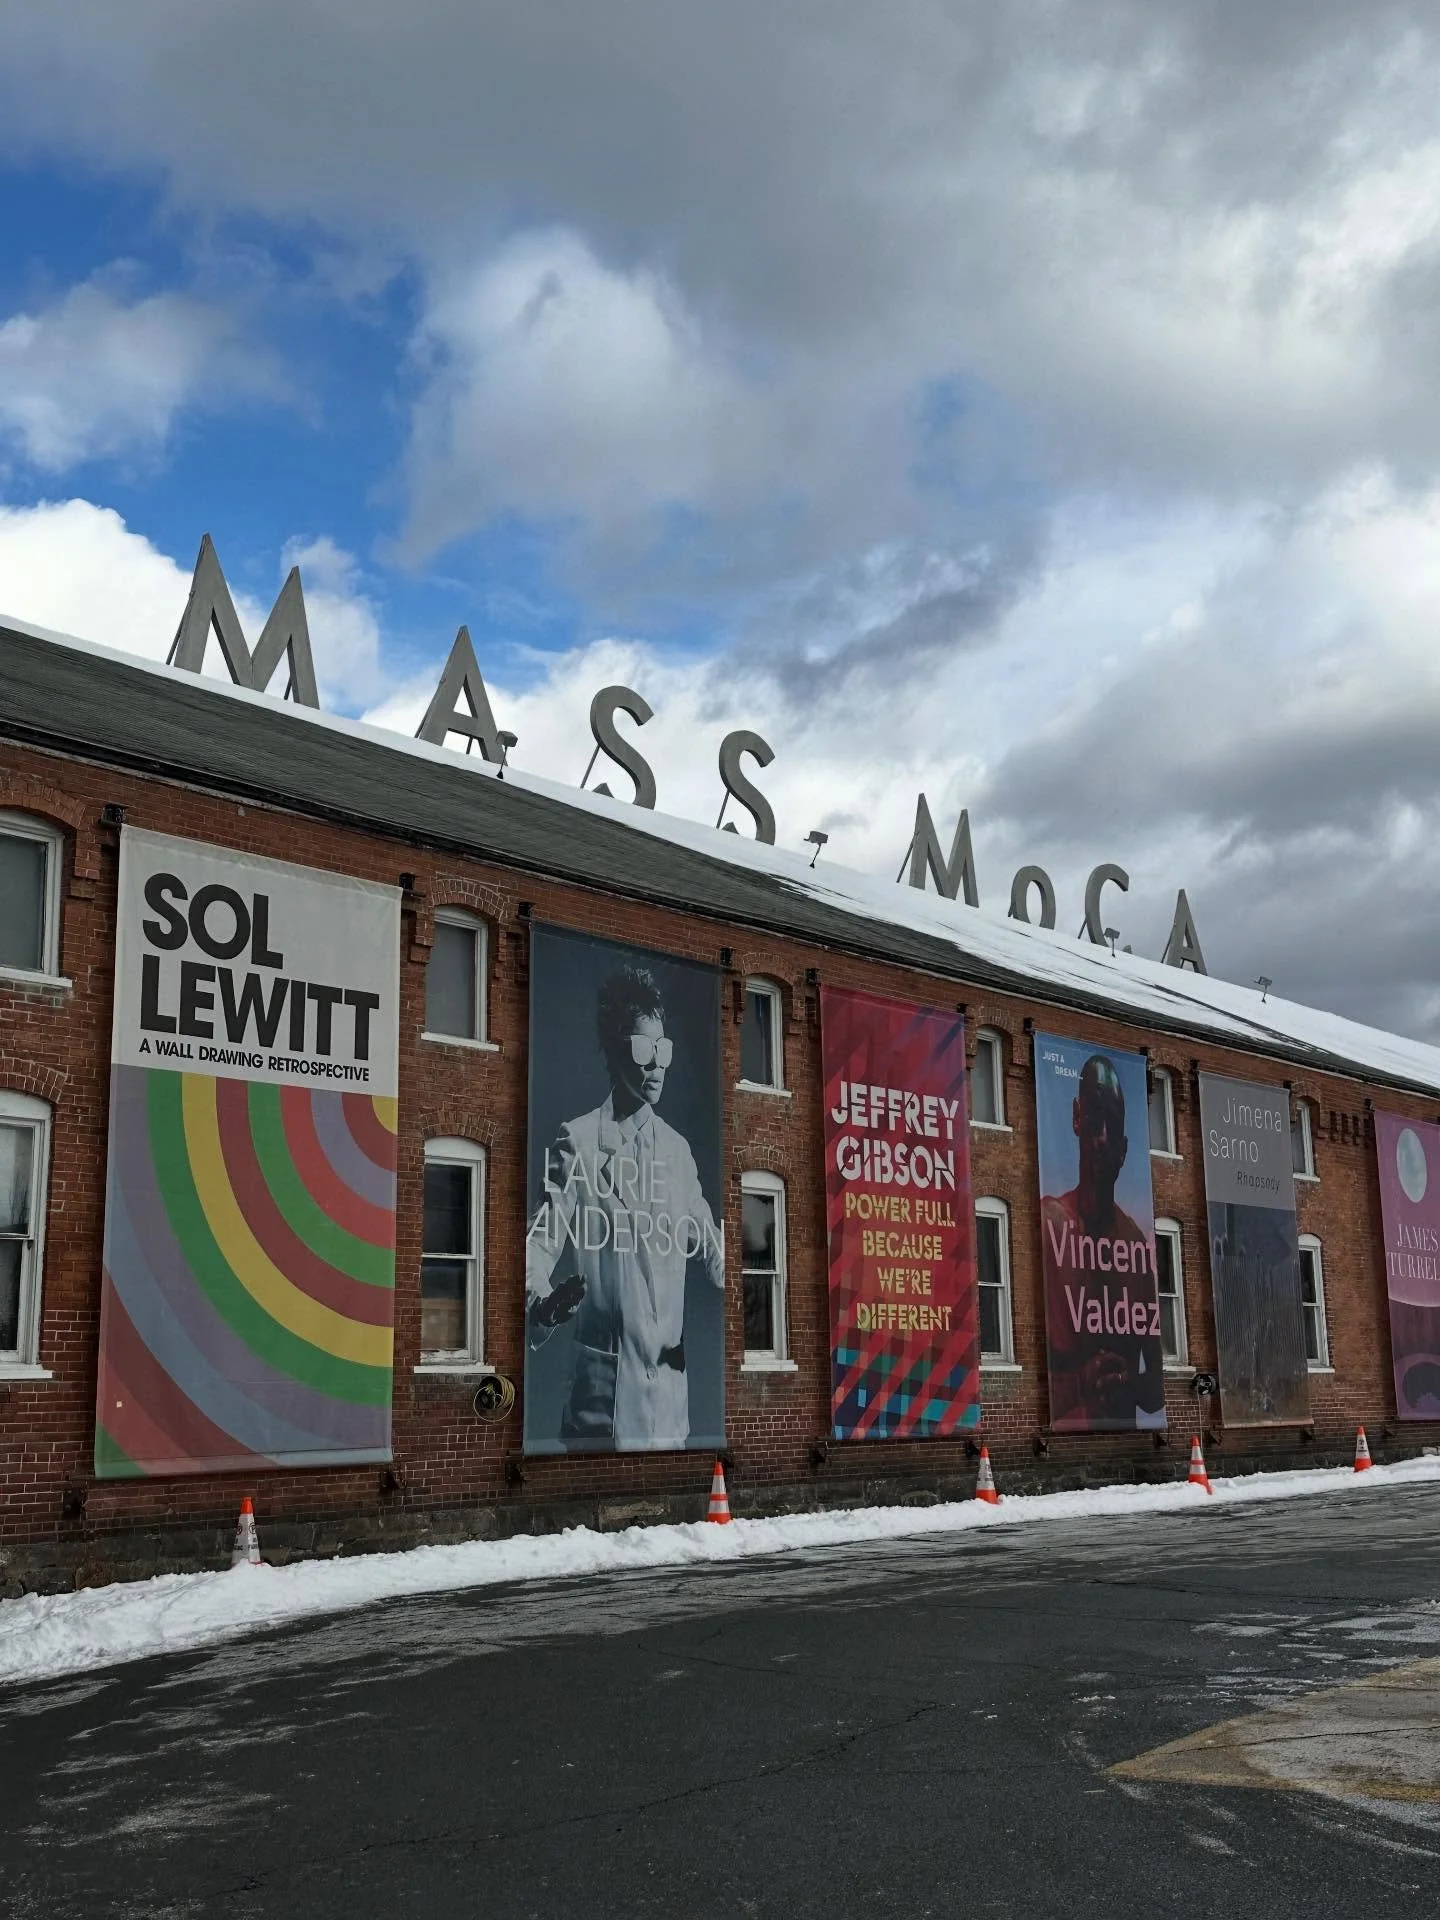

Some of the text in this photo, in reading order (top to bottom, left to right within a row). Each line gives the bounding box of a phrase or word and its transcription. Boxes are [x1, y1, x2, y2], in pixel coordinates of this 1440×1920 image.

[174, 532, 776, 846] MASS
[142, 872, 283, 969] SOL
[140, 953, 379, 1060] LEWITT
[139, 1038, 369, 1081] A WALL DRAWING RETROSPECTIVE
[1042, 1050, 1059, 1063] JUST
[831, 1080, 959, 1140] JEFFREY
[1222, 1098, 1282, 1132] Jimena
[836, 1136, 955, 1191] GIBSON
[1209, 1129, 1259, 1162] Sarno
[544, 1148, 667, 1203] LAURIE
[1237, 1171, 1281, 1194] Rhapsody
[526, 1201, 725, 1260] ANDERSON
[863, 1229, 943, 1260] BECAUSE
[1047, 1219, 1157, 1274] Vincent
[1398, 1224, 1438, 1252] JAMES
[877, 1266, 932, 1294] WE'RE
[856, 1302, 953, 1331] DIFFERENT
[1064, 1284, 1160, 1335] Valdez
